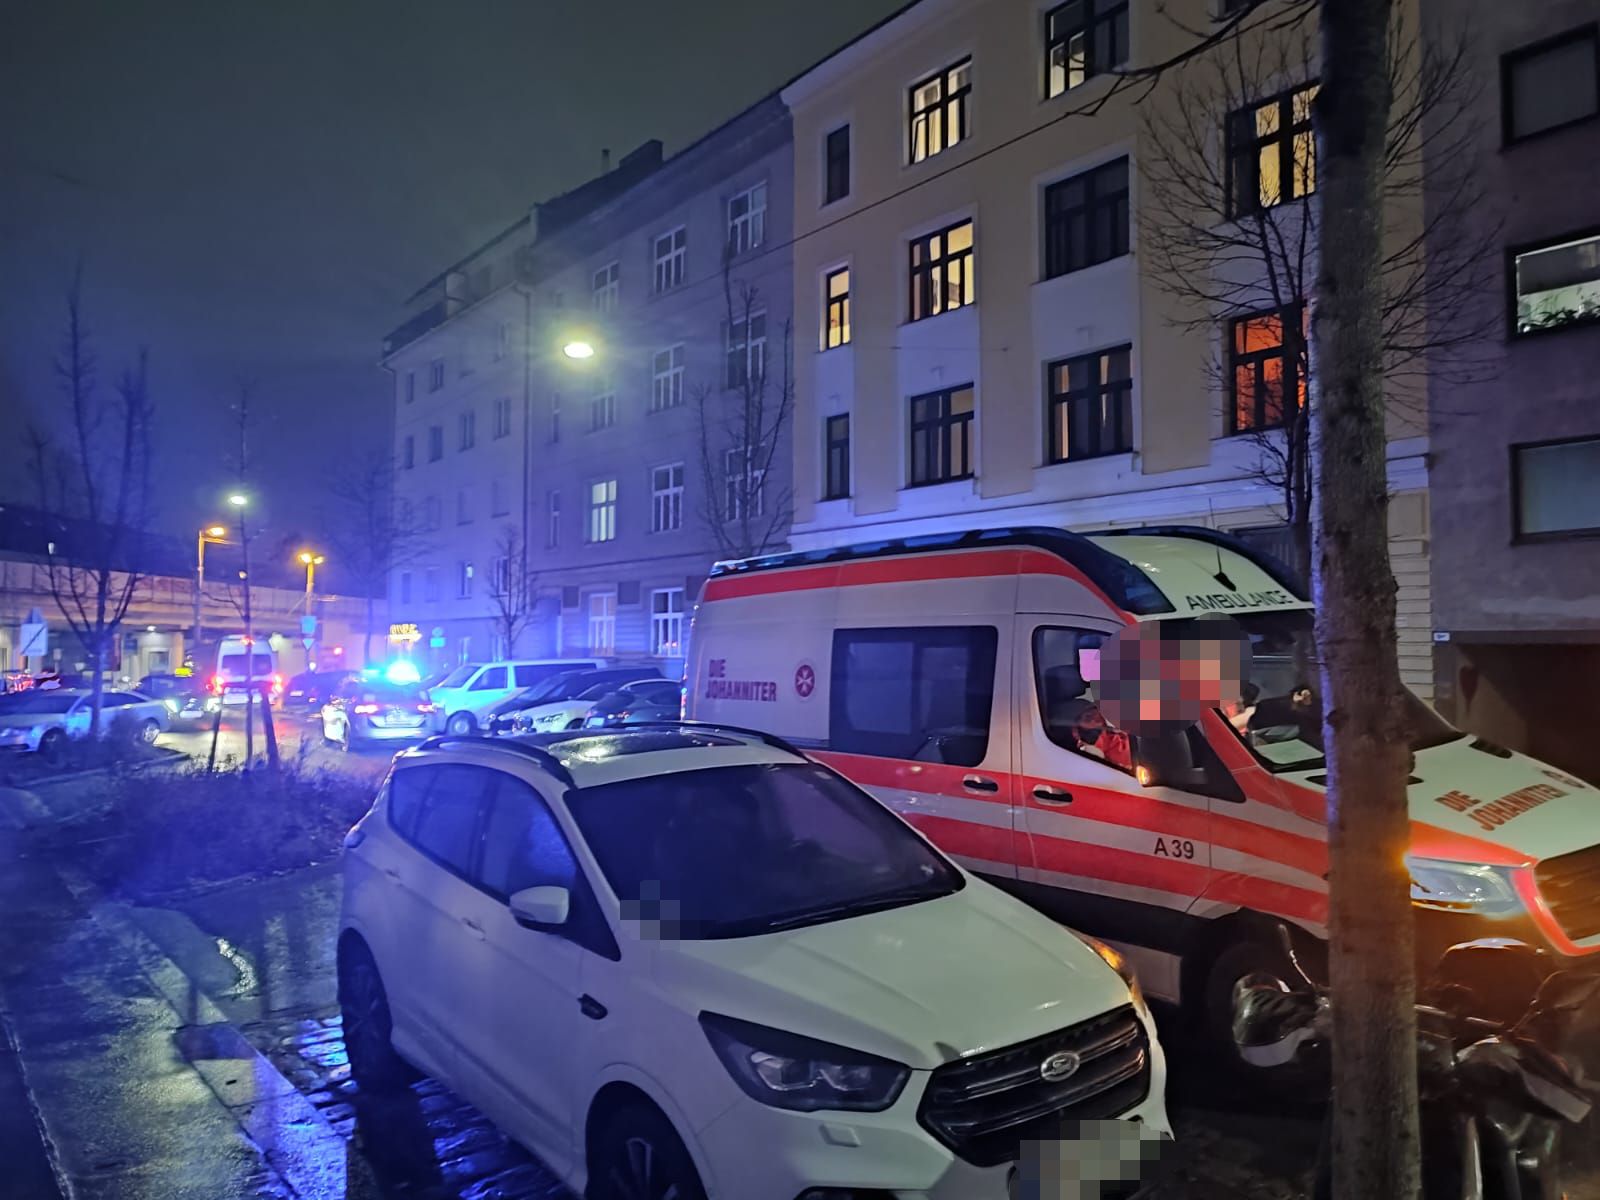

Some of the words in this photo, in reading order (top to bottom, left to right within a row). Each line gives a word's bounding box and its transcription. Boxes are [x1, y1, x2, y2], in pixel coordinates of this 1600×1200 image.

[1185, 591, 1294, 610] AMBULANCE
[705, 680, 777, 702] JOHANNITER
[1434, 790, 1482, 812] DIE
[1154, 837, 1169, 857] A
[1171, 839, 1194, 859] 39
